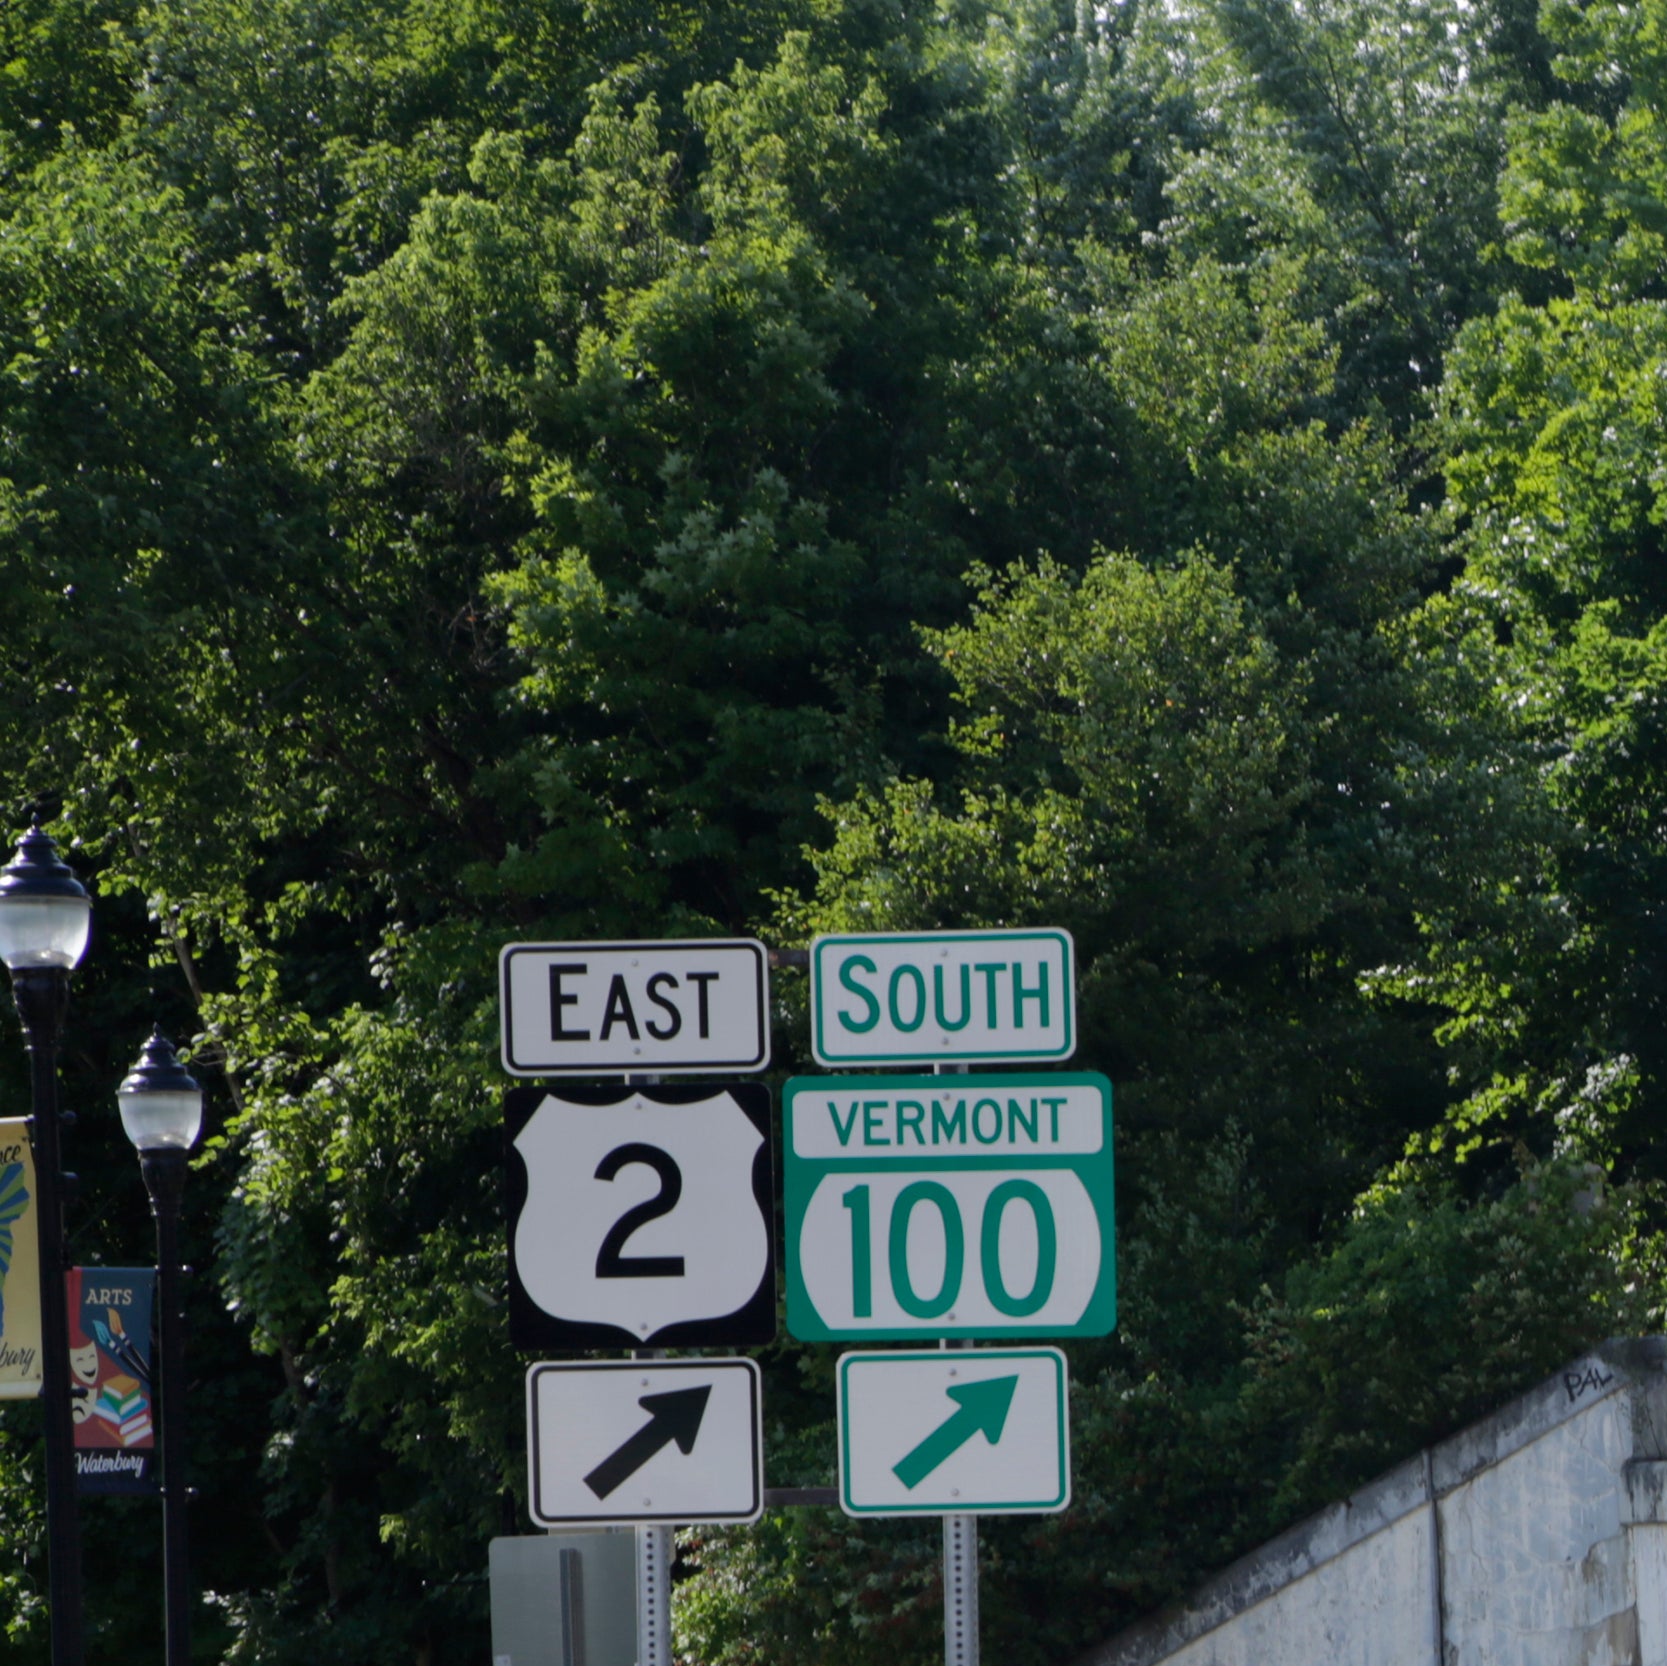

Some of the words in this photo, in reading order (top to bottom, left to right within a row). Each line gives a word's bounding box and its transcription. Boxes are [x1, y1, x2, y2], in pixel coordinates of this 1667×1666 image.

[549, 963, 720, 1041] EAST
[837, 954, 1050, 1034] SOUTH
[827, 1098, 1068, 1147] VERMONT
[594, 1142, 685, 1278] 2
[842, 1179, 1057, 1319] 100
[85, 1288, 132, 1305] ARTS
[74, 1451, 144, 1478] Waterbury
